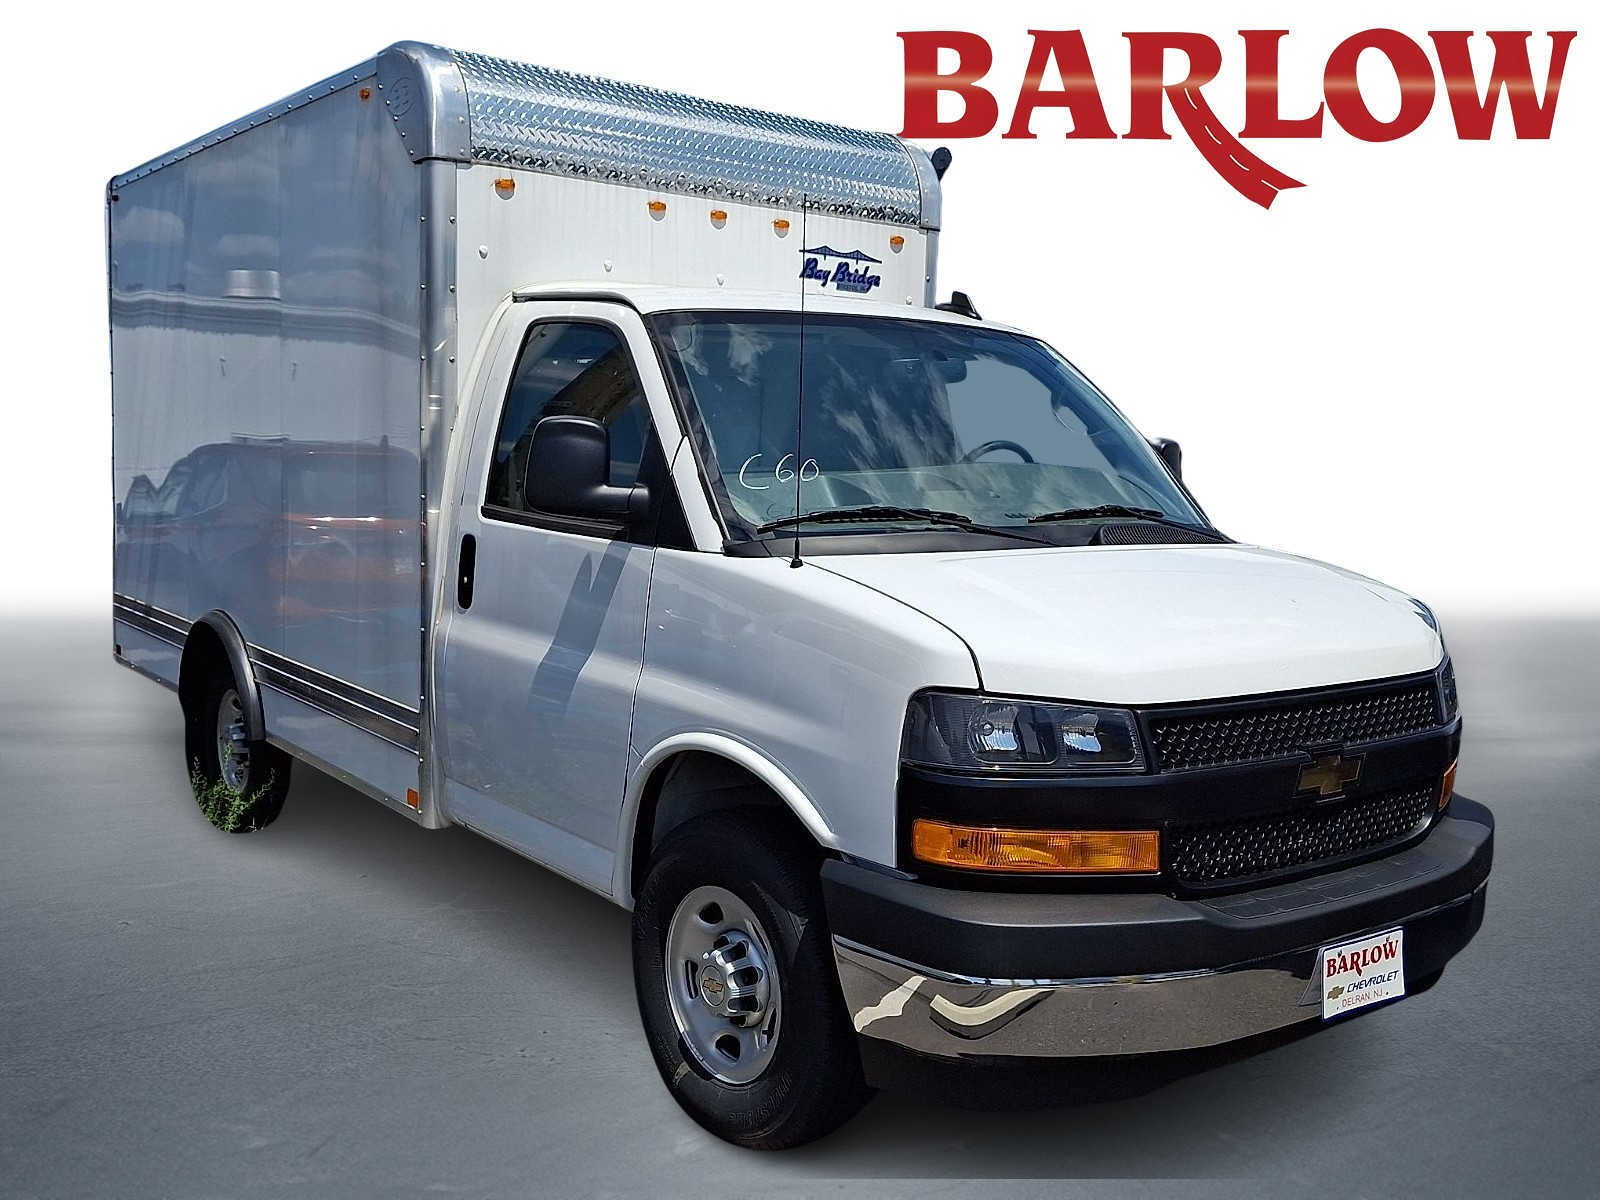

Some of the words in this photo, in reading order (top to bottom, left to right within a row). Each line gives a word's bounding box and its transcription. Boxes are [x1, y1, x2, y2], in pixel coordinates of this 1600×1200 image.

[799, 258, 831, 287] Bay
[830, 262, 881, 293] Bridge
[1326, 940, 1399, 977] BARLOW
[1346, 970, 1399, 993] CHEVROLET
[1341, 992, 1370, 1008] DELRAN
